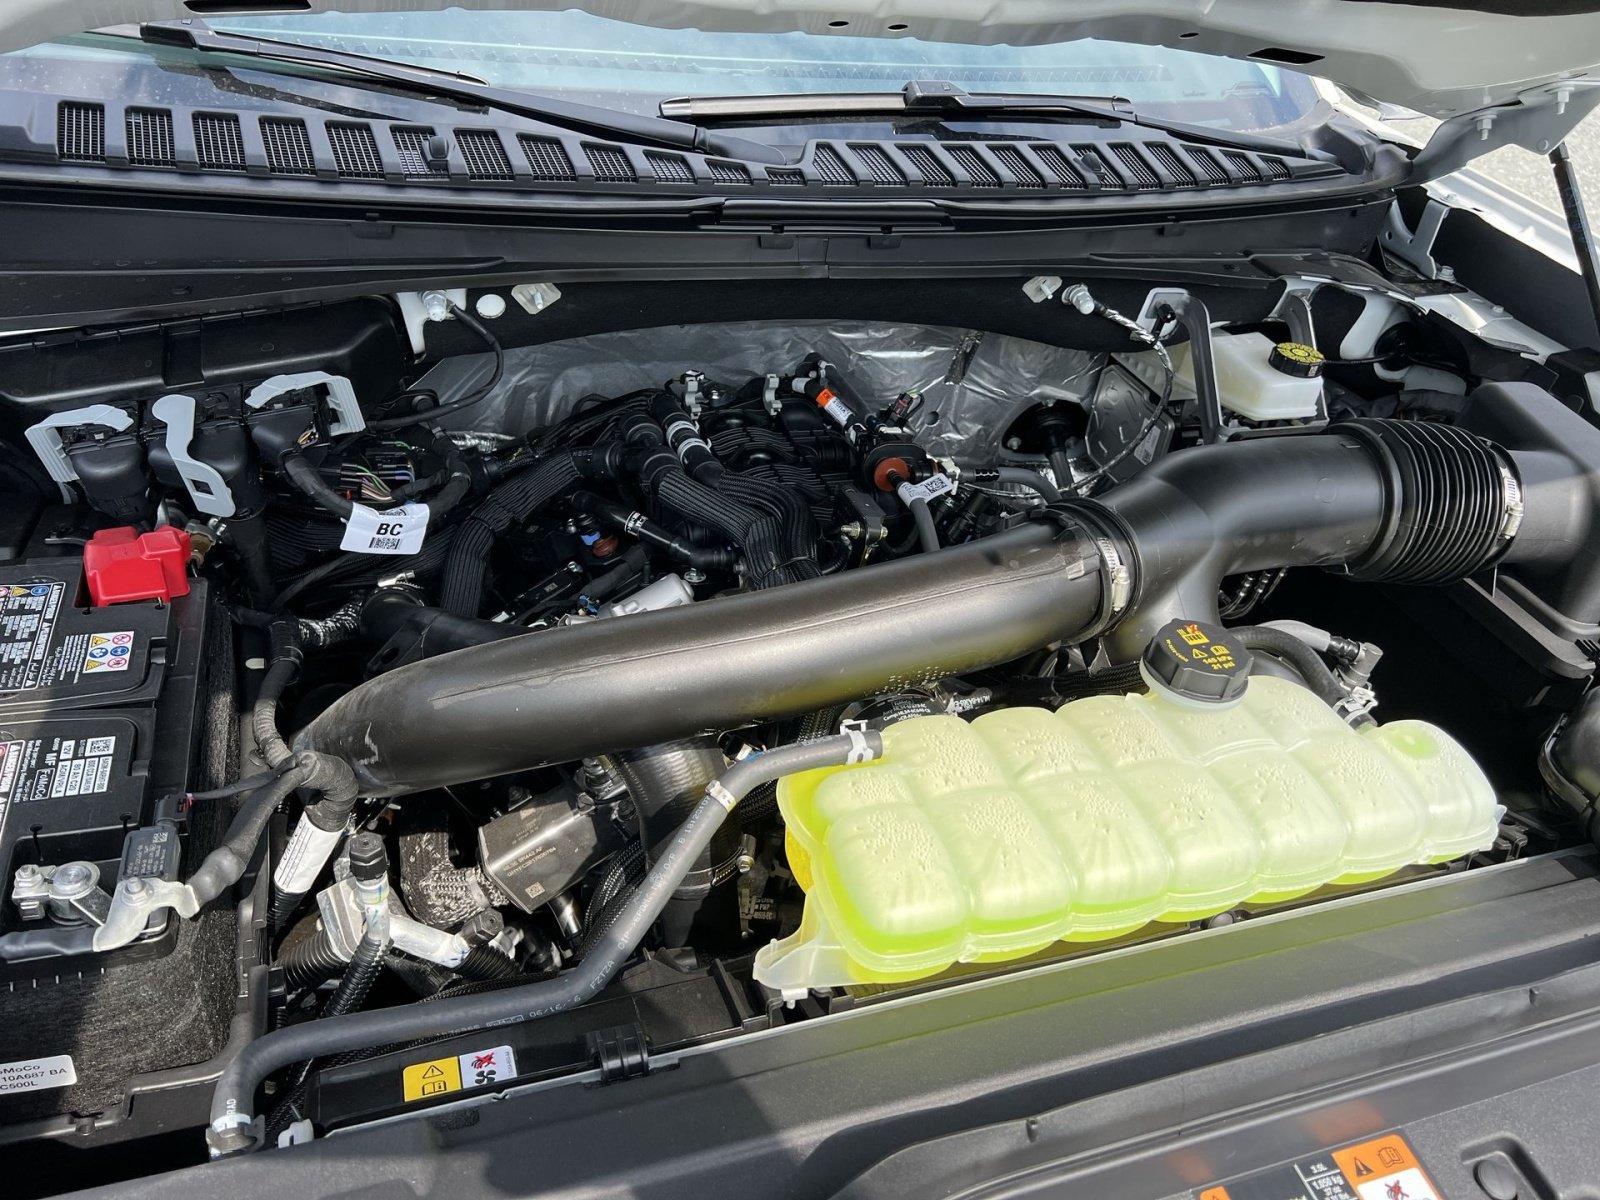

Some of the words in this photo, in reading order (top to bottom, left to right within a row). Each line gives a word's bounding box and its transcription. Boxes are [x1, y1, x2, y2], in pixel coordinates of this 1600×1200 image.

[376, 523, 403, 535] BC
[63, 744, 71, 754] 12V
[44, 752, 57, 765] MF
[71, 771, 79, 779] Ah
[34, 769, 50, 798] FoMoCo
[68, 779, 77, 791] C20
[1, 1072, 45, 1081] 10A687
[0, 1081, 38, 1090] C500L
[227, 1098, 236, 1115] RAD
[1331, 1175, 1344, 1185] kg
